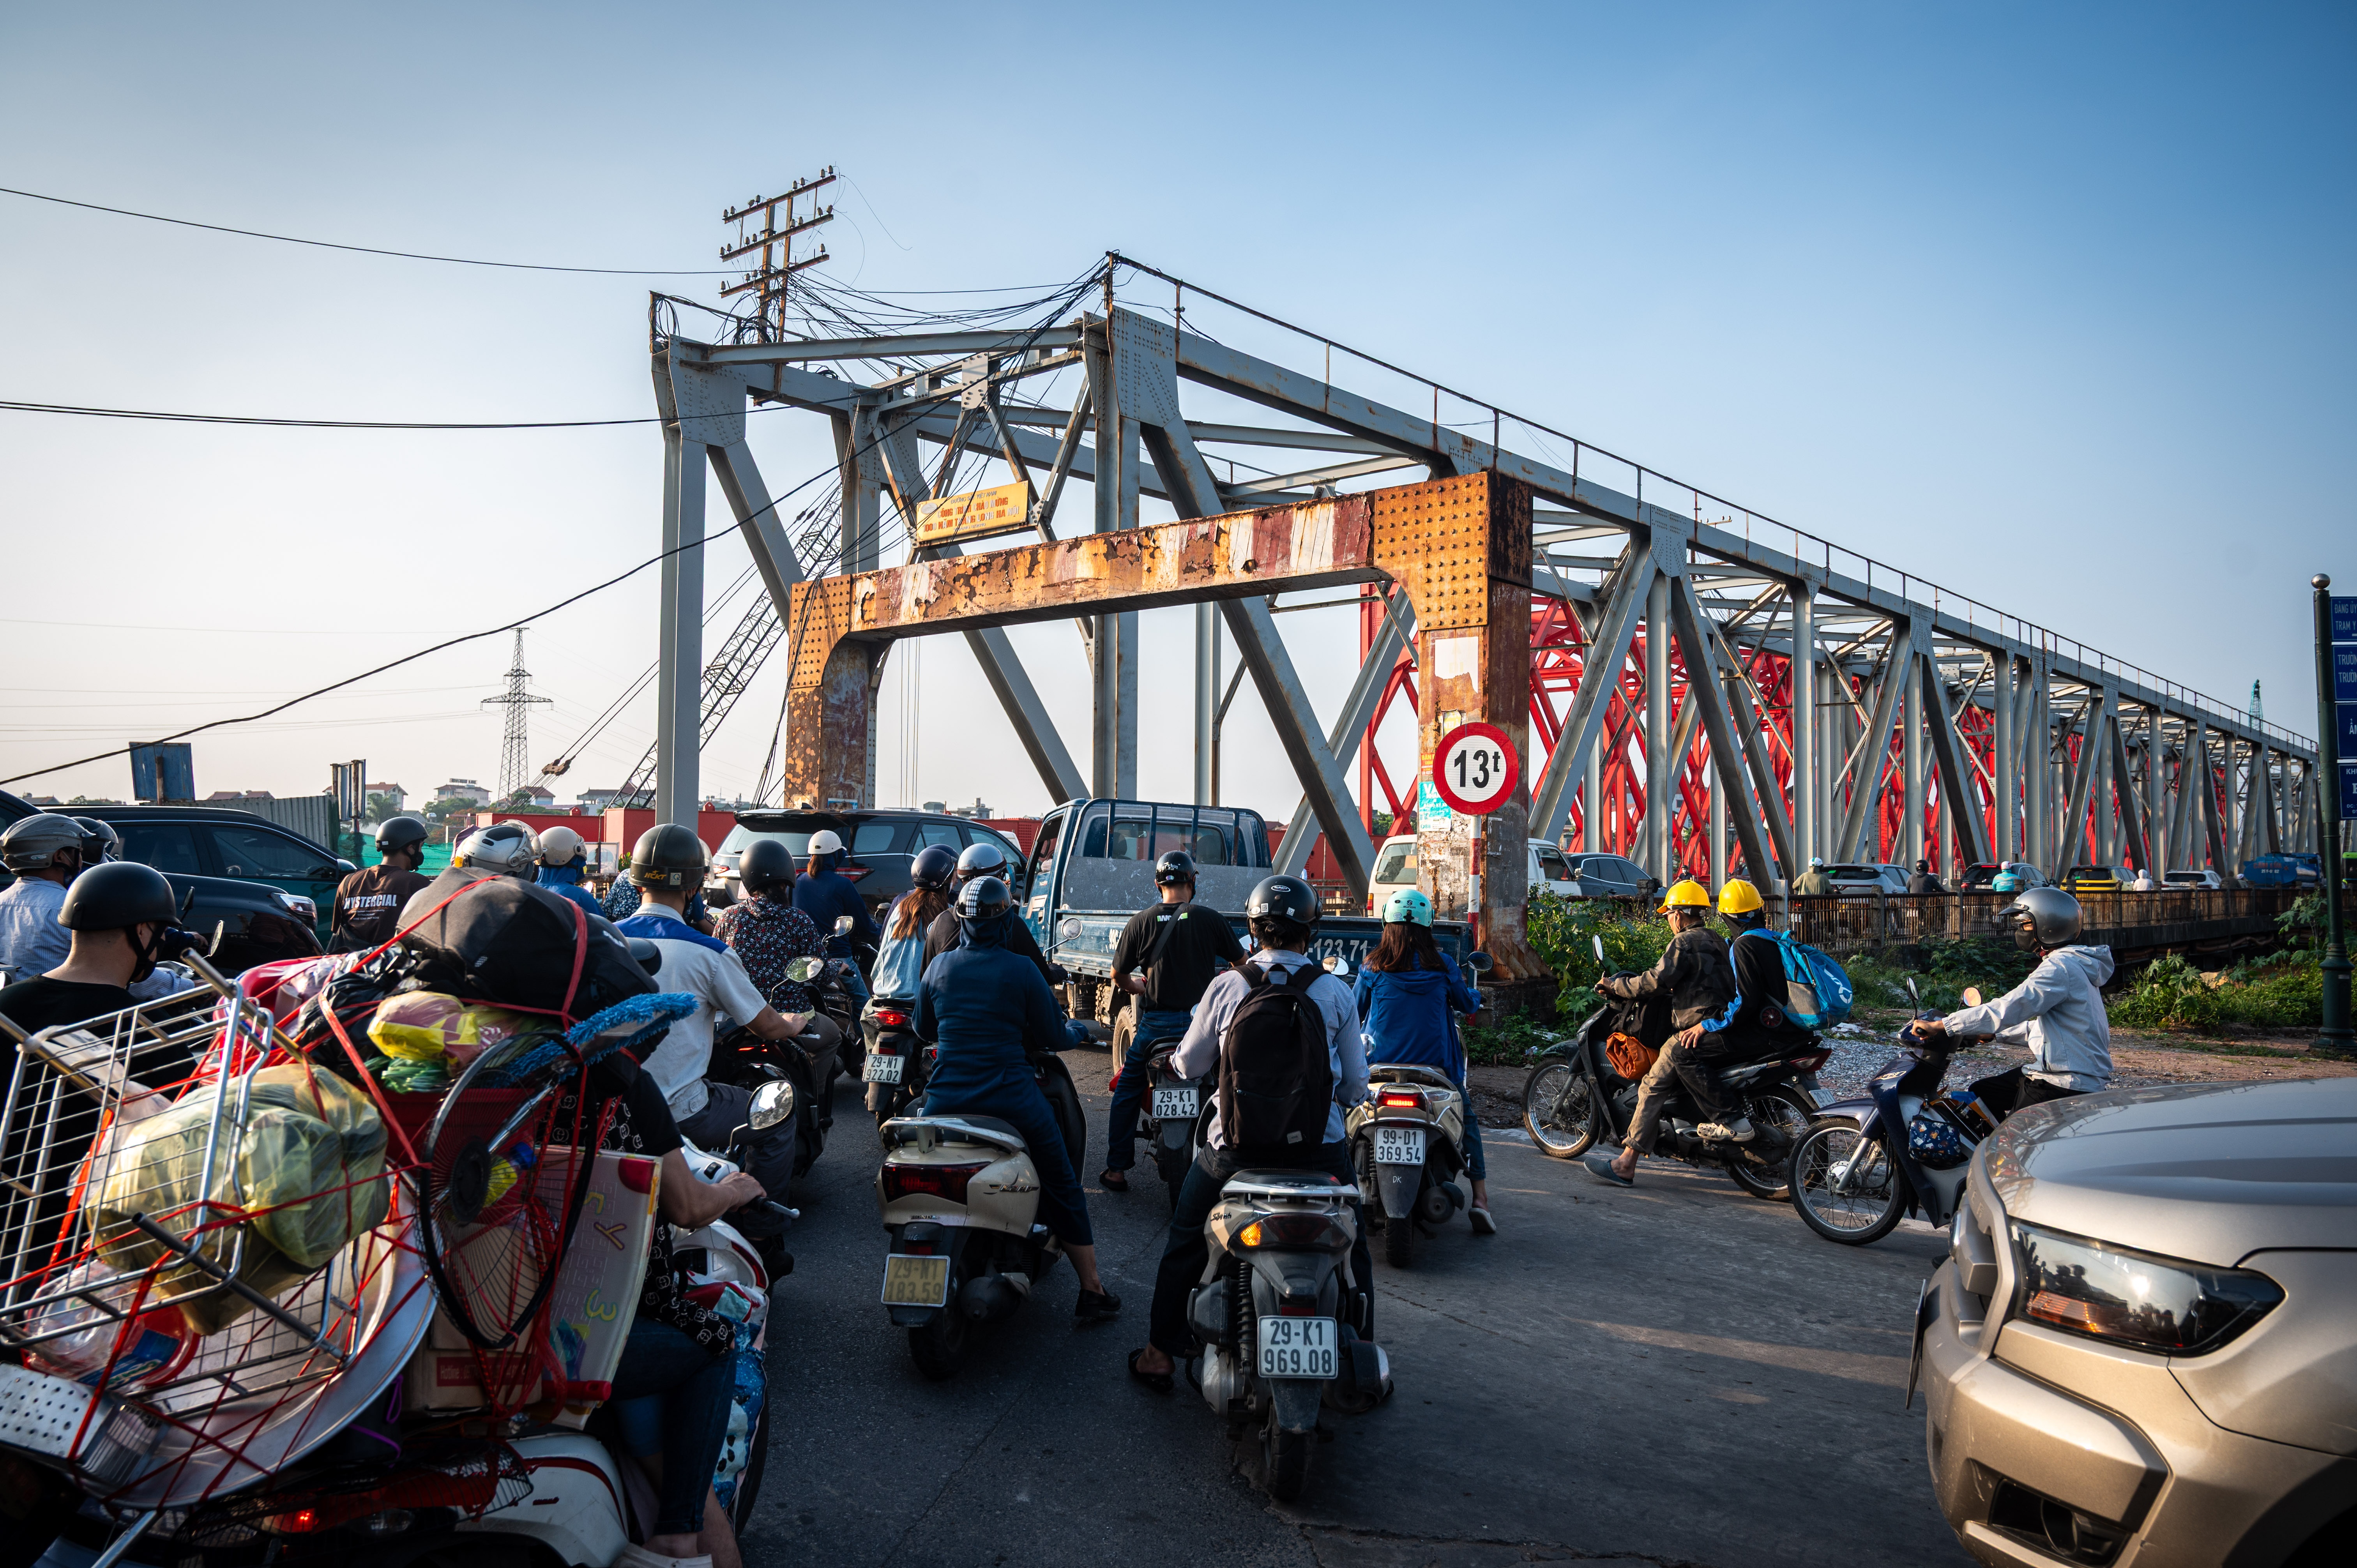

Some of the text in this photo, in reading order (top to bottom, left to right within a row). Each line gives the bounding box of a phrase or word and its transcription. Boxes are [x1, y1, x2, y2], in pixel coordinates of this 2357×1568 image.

[937, 508, 953, 519] CÔNG
[973, 500, 989, 512] CHÀO
[990, 496, 1008, 508] MỪNG
[923, 523, 937, 532] 1000
[938, 519, 953, 530] NĂM
[977, 512, 994, 522] LONG
[996, 507, 1005, 518] HÀ
[1007, 505, 1019, 517] NỘI
[2334, 601, 2357, 614] ĐẢNG ỦY
[2335, 621, 2351, 633] TRẠM
[1304, 938, 1368, 962] -123.71
[871, 1056, 898, 1069] 29-N1
[866, 1068, 899, 1082] 922.02
[1159, 1090, 1191, 1103] 29-K1
[1156, 1104, 1195, 1116] 028.42
[1383, 1130, 1417, 1146] 99-D1
[1378, 1146, 1421, 1162] 369.54
[888, 1281, 942, 1303] 183.59
[1270, 1320, 1323, 1346] 29-K1
[1264, 1348, 1332, 1374] 969.08
